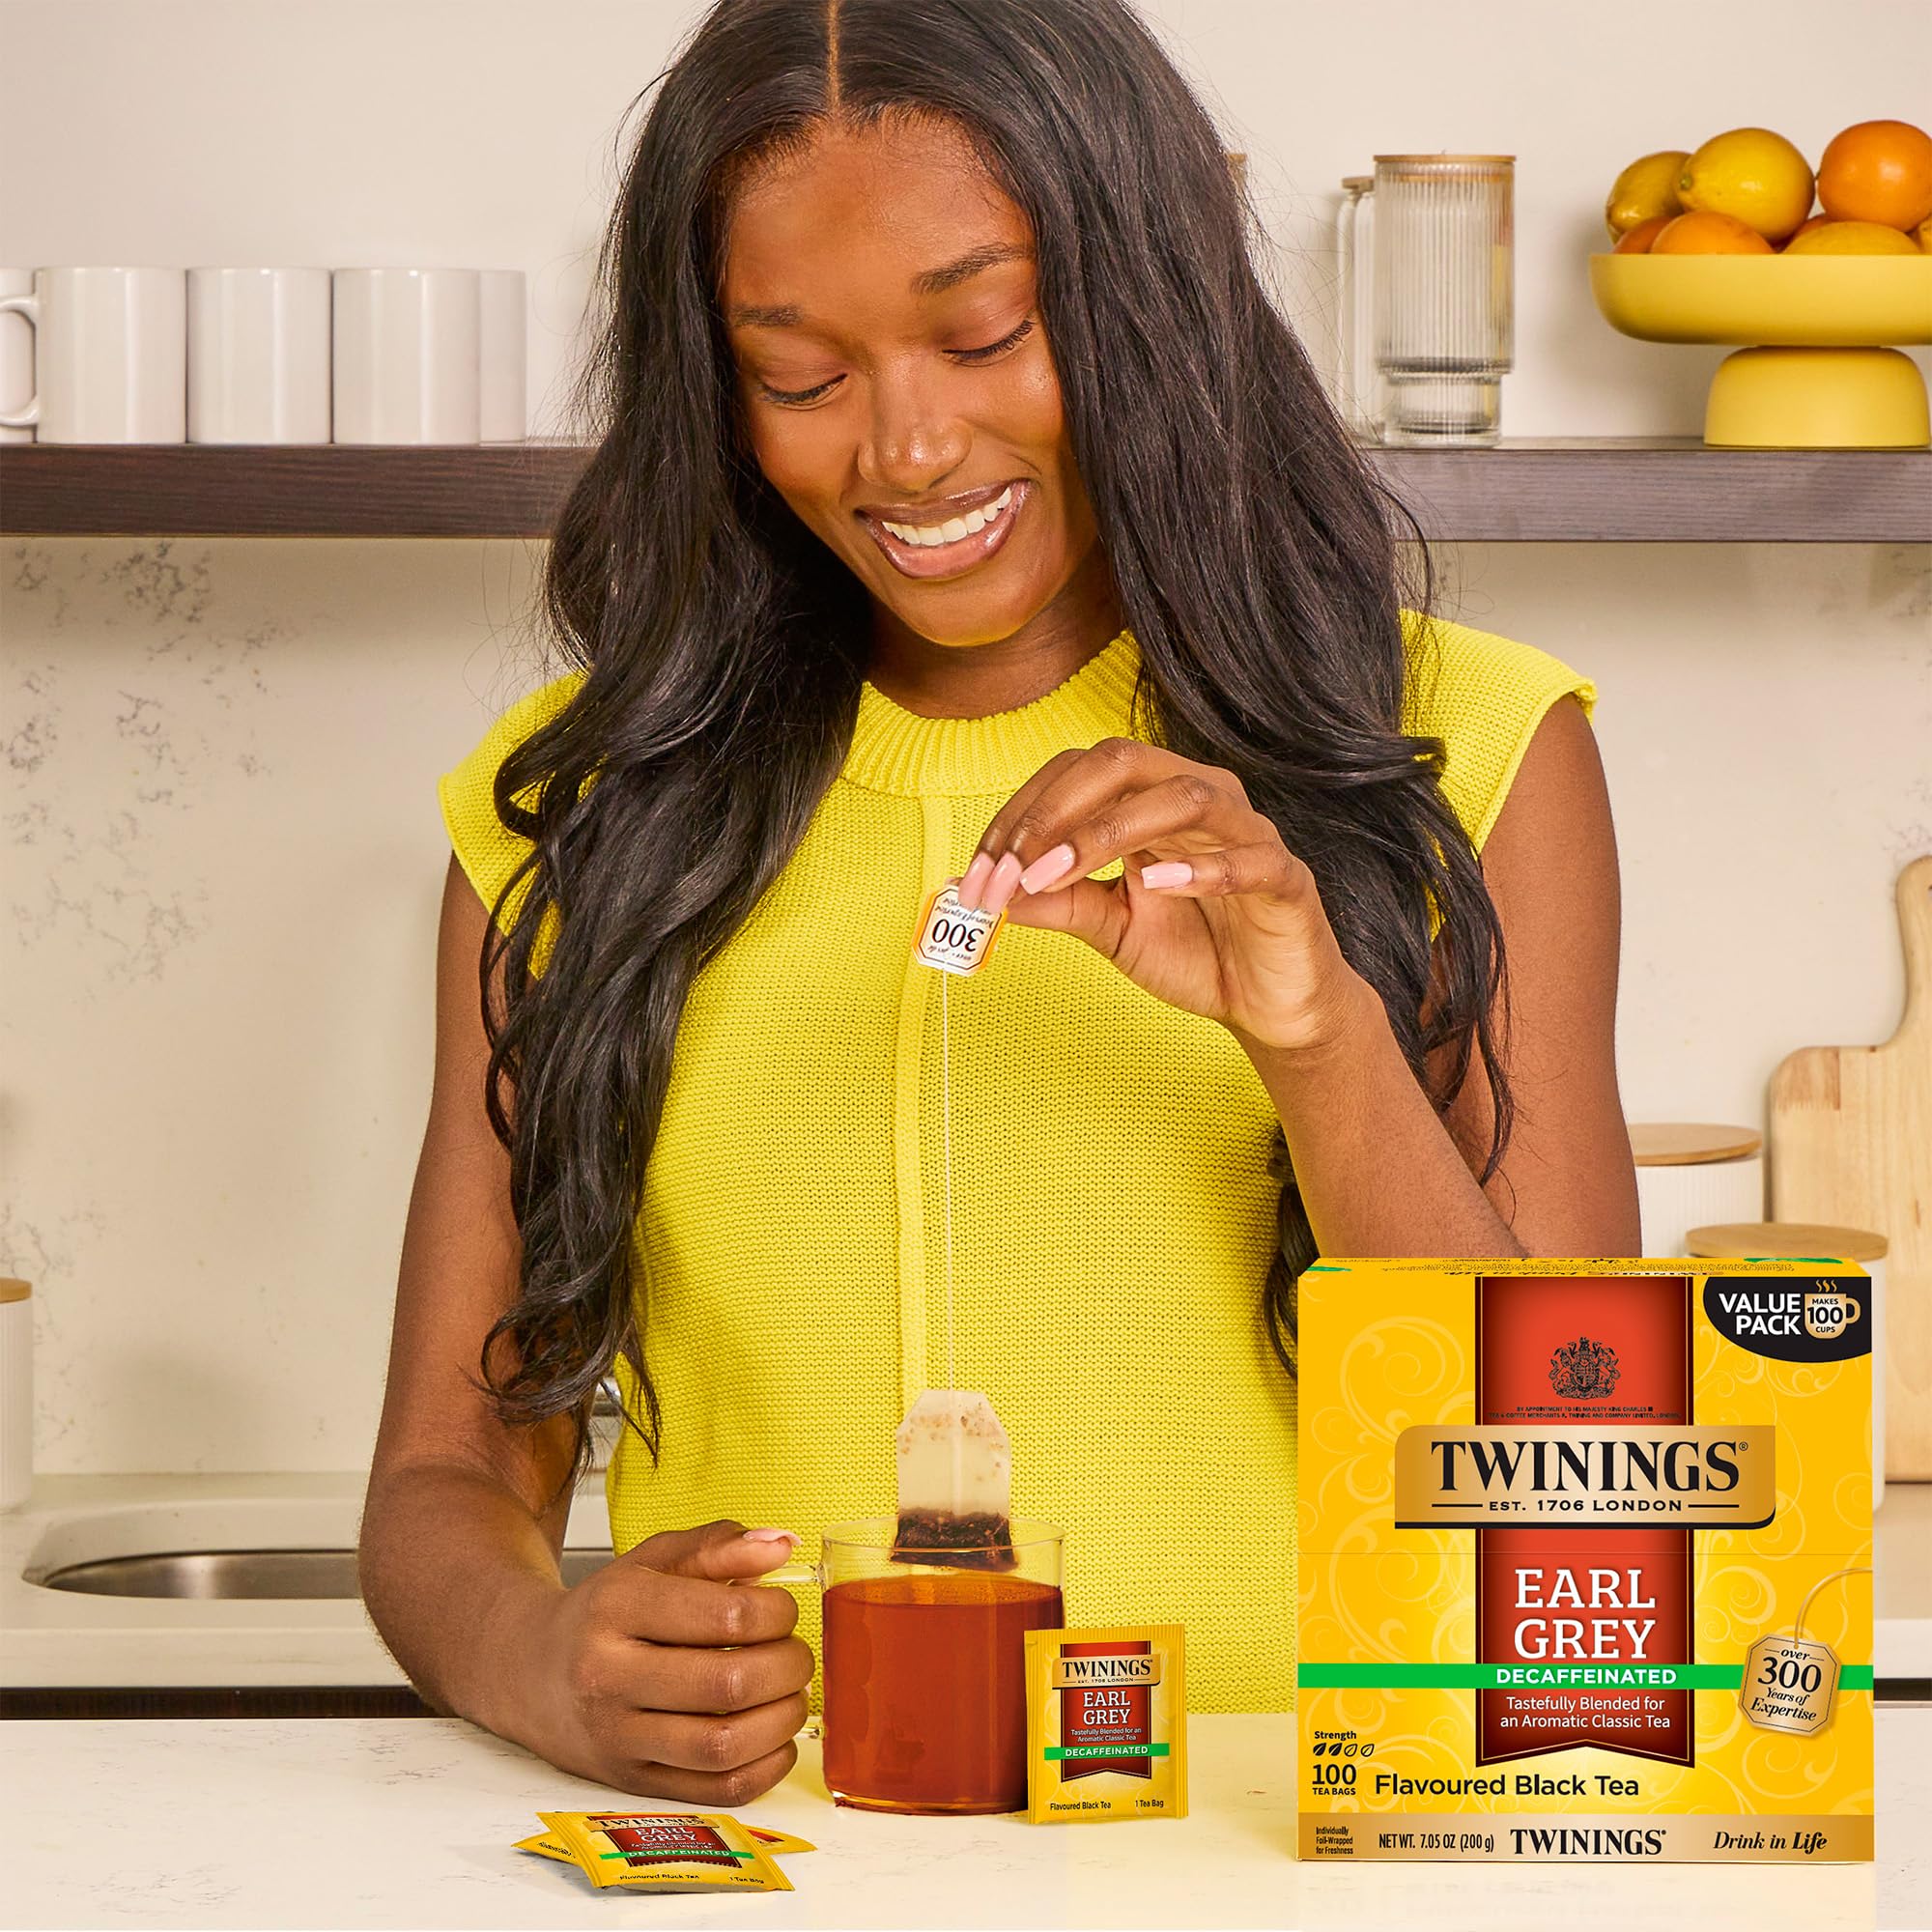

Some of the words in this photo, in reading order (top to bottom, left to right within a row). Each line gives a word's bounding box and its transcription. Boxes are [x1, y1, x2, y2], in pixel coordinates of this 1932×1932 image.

[932, 919, 984, 952] 300
[1719, 1293, 1802, 1314] VALUE
[1807, 1306, 1844, 1324] 100
[1736, 1315, 1802, 1335] PACK
[1489, 1500, 1526, 1511] EST.
[1537, 1500, 1584, 1511] 1706
[1593, 1500, 1682, 1511] LONDON
[1515, 1568, 1656, 1609] EARL
[1514, 1618, 1656, 1660] GREY
[1780, 1648, 1810, 1661] over
[1496, 1668, 1677, 1685] DECAFFEINATED
[1757, 1656, 1822, 1692] 300
[1083, 1690, 1130, 1707] EARL
[1506, 1696, 1577, 1714] Tastefully
[1579, 1696, 1640, 1710] Blended
[1644, 1696, 1665, 1710] for
[1767, 1687, 1795, 1702] Years
[1795, 1694, 1810, 1706] of
[1083, 1709, 1131, 1724] GREY
[1750, 1697, 1817, 1721] Expertise
[1500, 1716, 1519, 1728] an
[1521, 1715, 1589, 1728] Aromatic
[1592, 1715, 1642, 1728] Classic
[1645, 1715, 1670, 1728] Tea
[1071, 1727, 1098, 1736] Tastefully
[1314, 1730, 1357, 1741] Strength
[1065, 1746, 1149, 1757] DECAFFEINATED
[1312, 1764, 1357, 1785] 100
[1375, 1774, 1505, 1796] Flavoured
[1516, 1775, 1587, 1796] Black
[1594, 1776, 1639, 1796] Tea
[1050, 1802, 1080, 1810] Flavoured
[1082, 1801, 1099, 1809] Black
[1151, 1799, 1164, 1807] Bag
[635, 1827, 694, 1835] EARL
[1316, 1826, 1349, 1835] Individually
[1316, 1836, 1353, 1846] Foil-Wrapped
[1378, 1834, 1397, 1849] NET
[1400, 1834, 1416, 1849] WT.
[1420, 1833, 1441, 1849] 7.05
[1442, 1833, 1456, 1849] OZ
[1460, 1833, 1483, 1853] (200
[1485, 1833, 1494, 1853] g)
[1713, 1832, 1765, 1849] Drink
[1770, 1834, 1786, 1849] in
[1792, 1832, 1828, 1855] Life
[1325, 1846, 1353, 1855] Freshness
